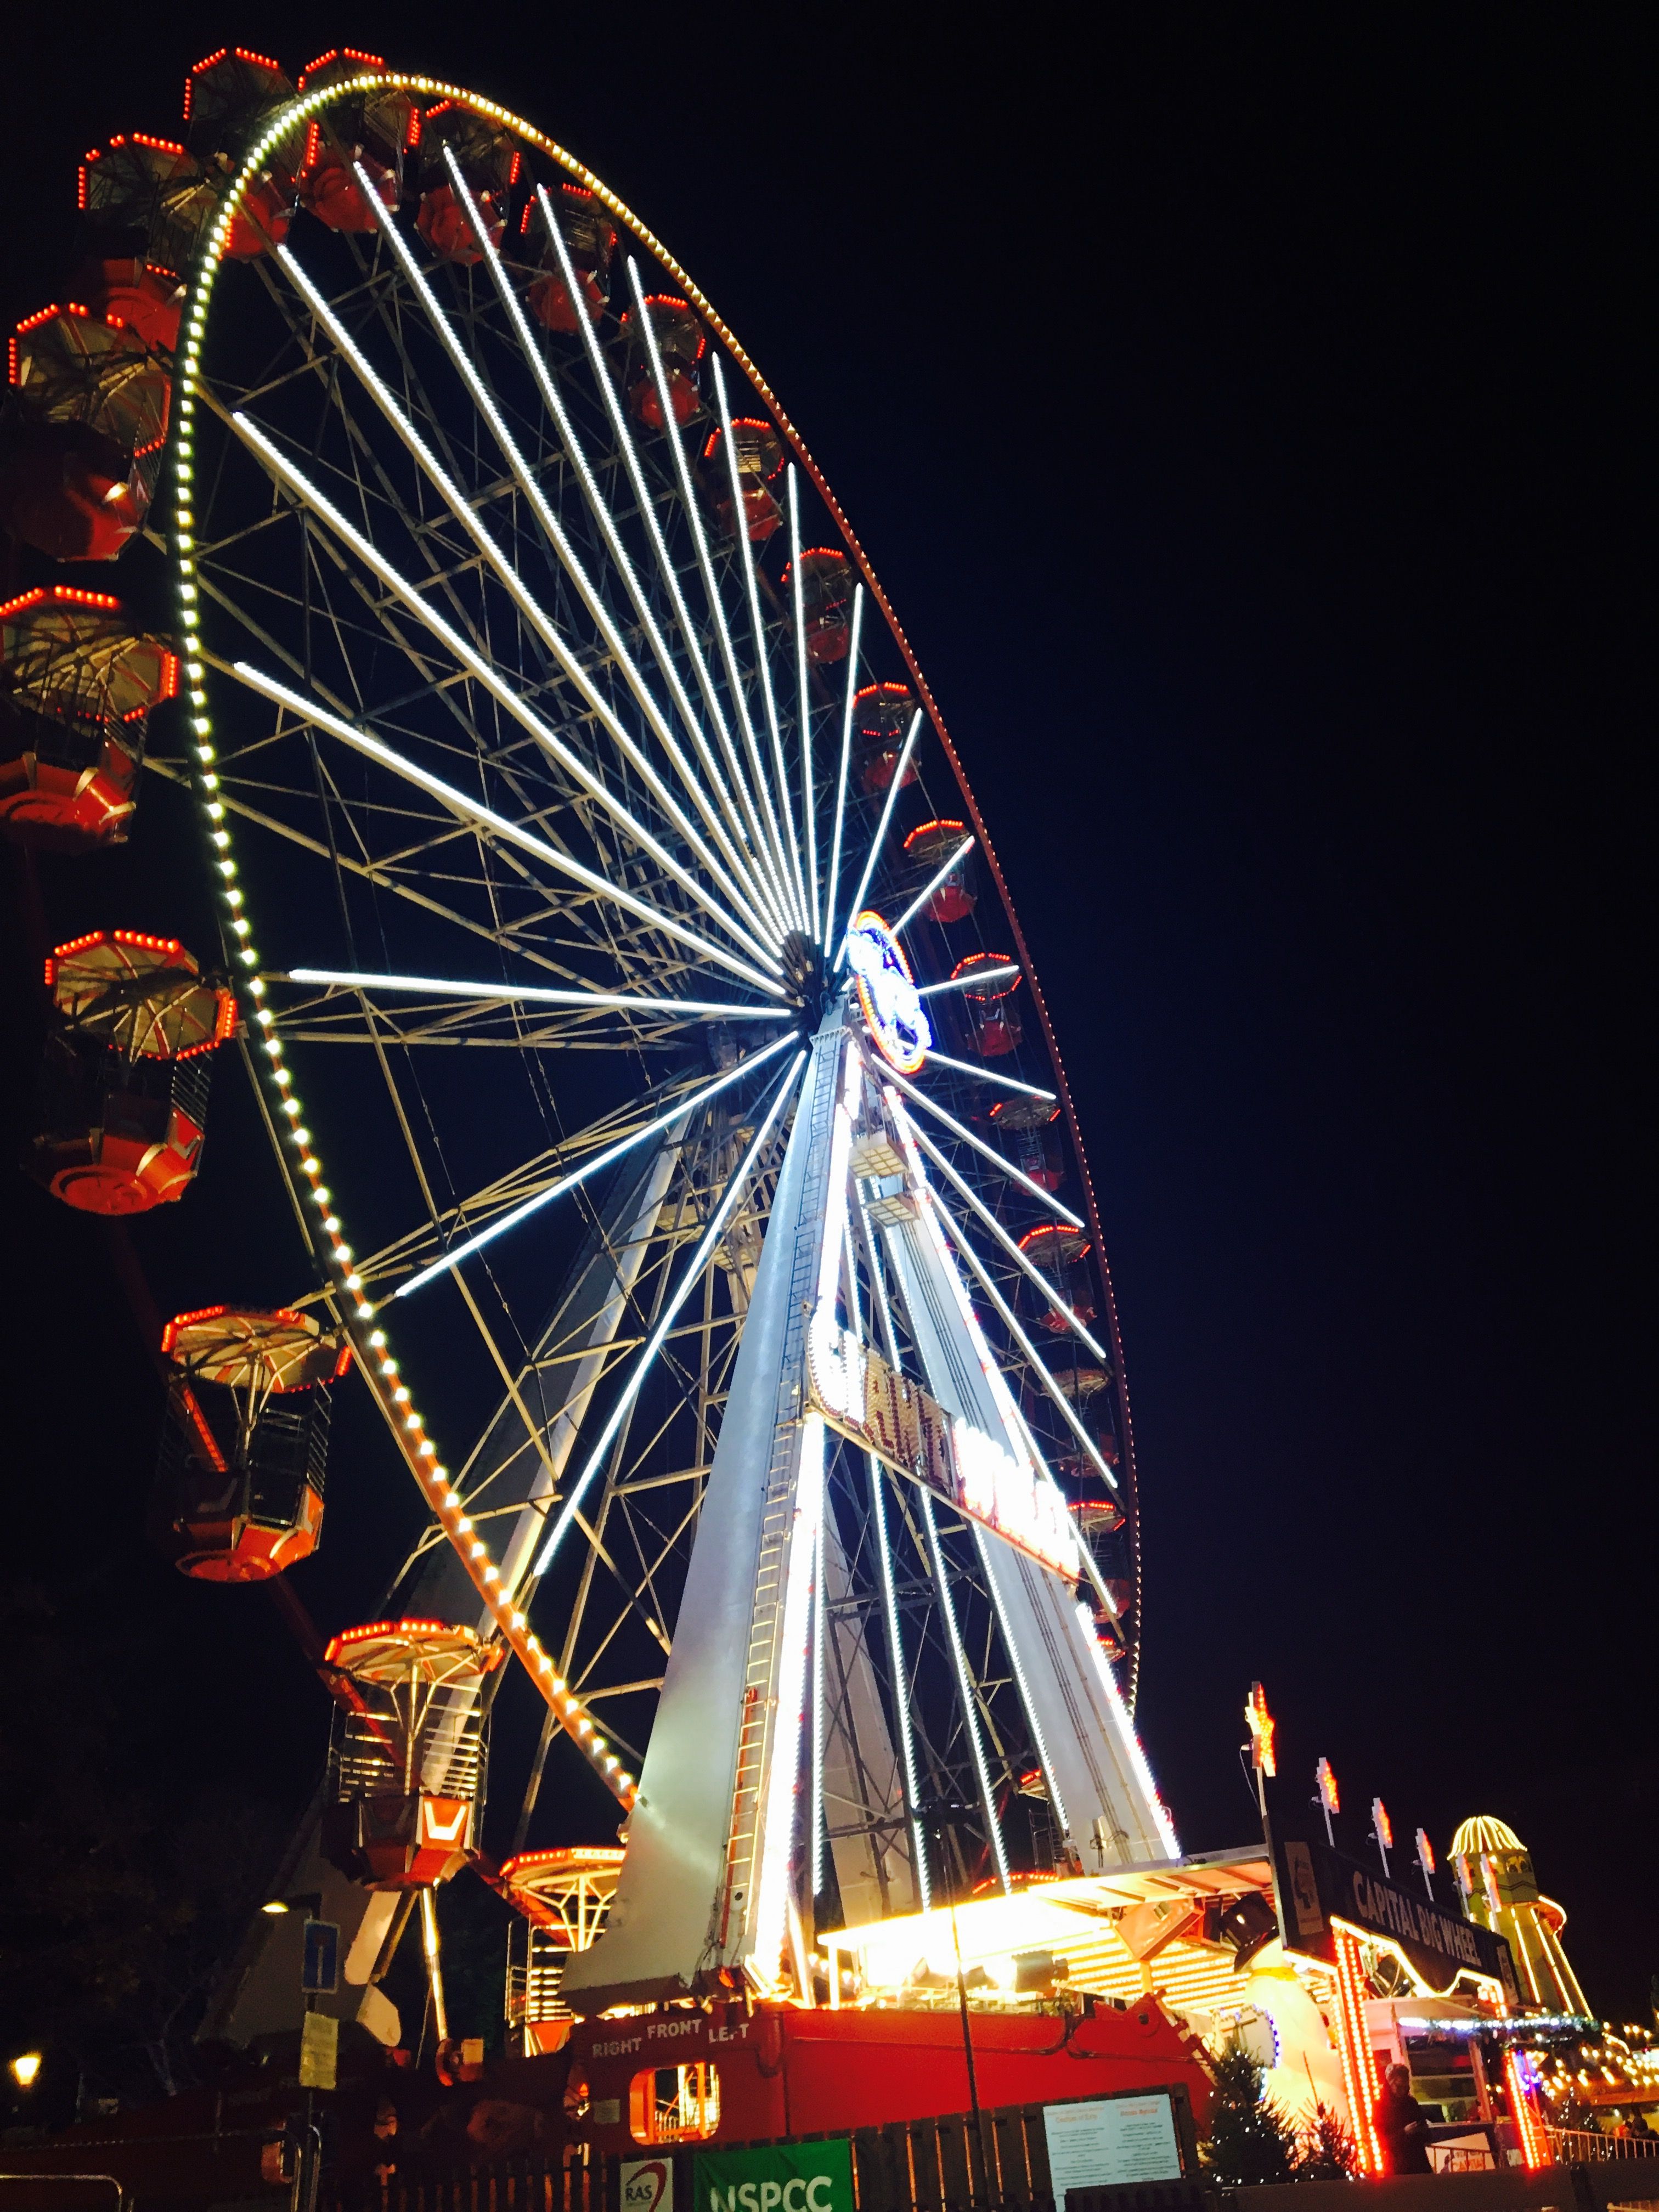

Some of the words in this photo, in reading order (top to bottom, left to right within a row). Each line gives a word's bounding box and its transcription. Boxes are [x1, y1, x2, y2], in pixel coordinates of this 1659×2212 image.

[1353, 1870, 1420, 1941] CAPITAL
[1416, 1903, 1444, 1953] BIG
[1438, 1914, 1482, 1967] WHEEL
[592, 2037, 642, 2057] RIGHT
[647, 2019, 702, 2039] FRONT
[625, 2185, 653, 2201] RAS
[710, 2176, 832, 2212] NSPCC
